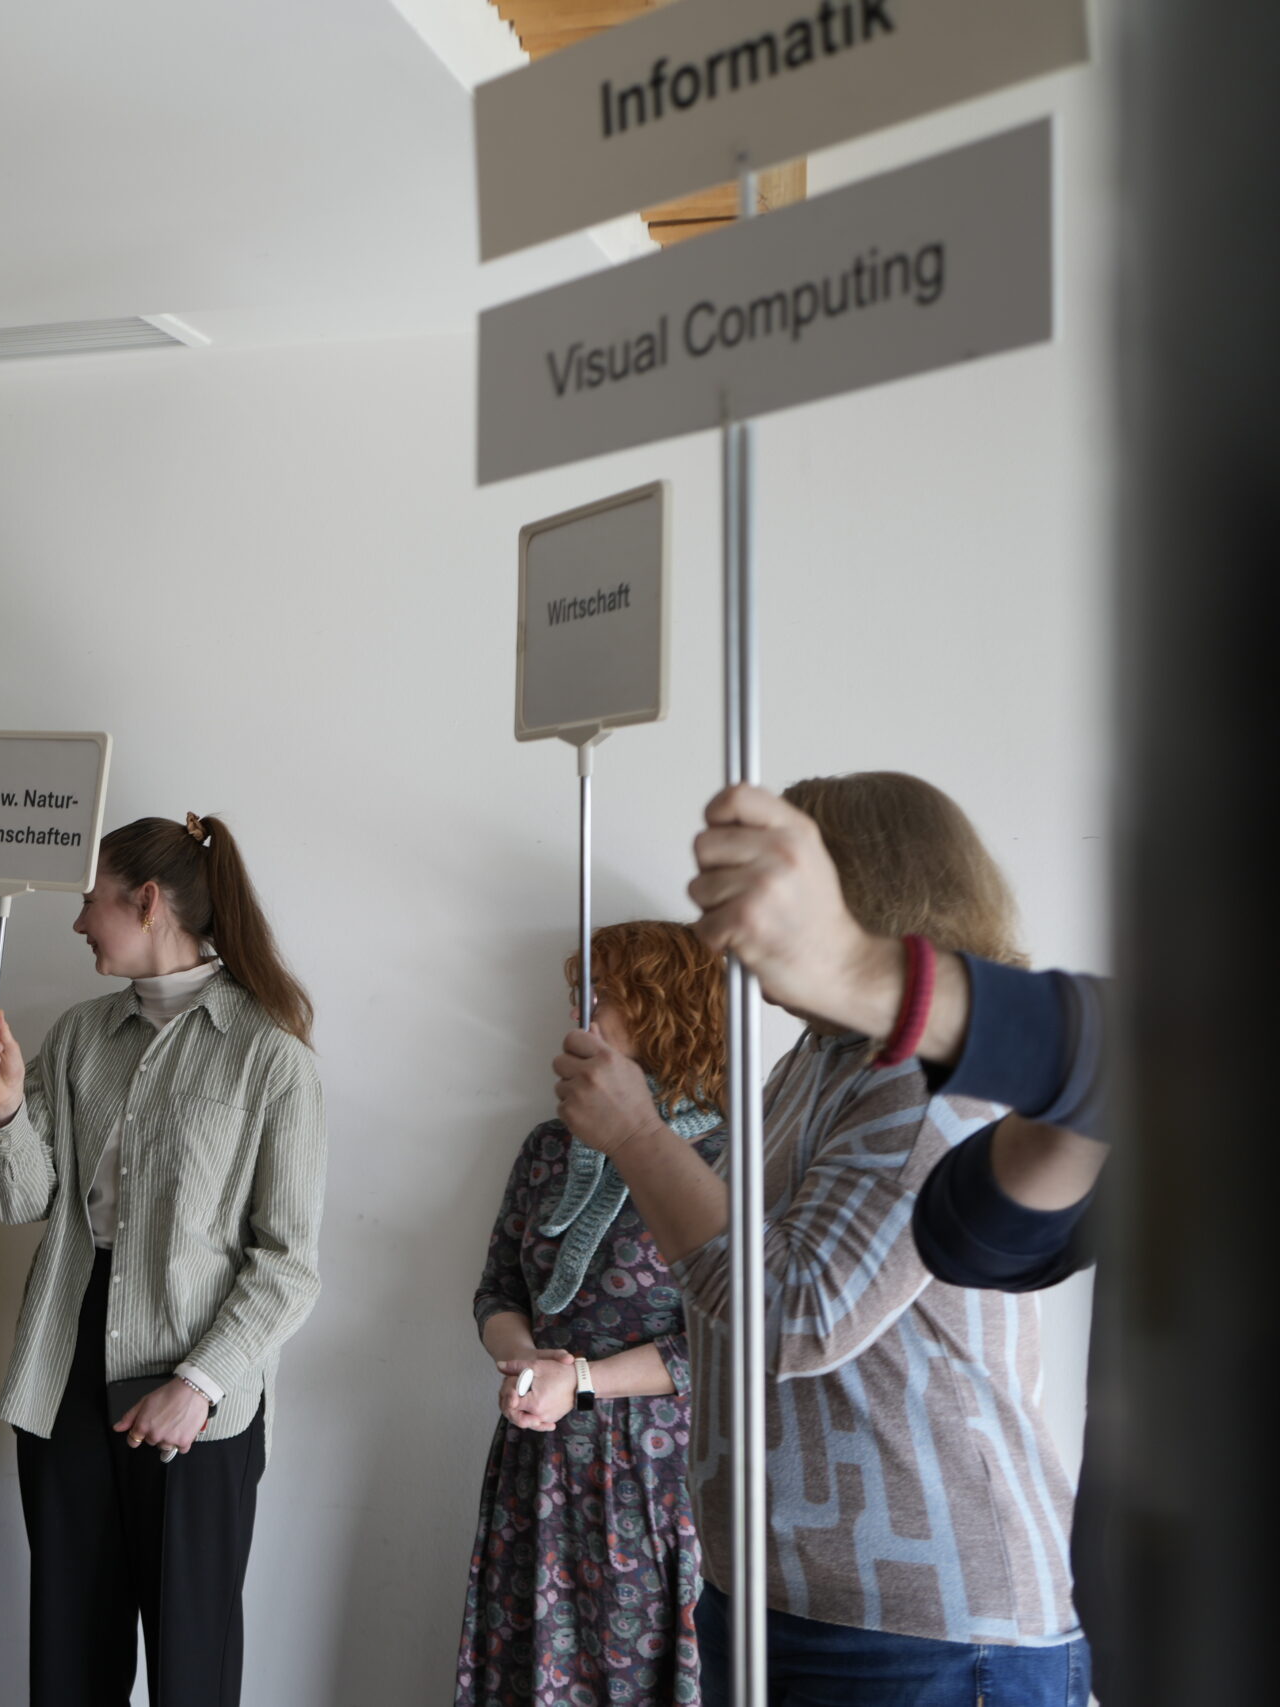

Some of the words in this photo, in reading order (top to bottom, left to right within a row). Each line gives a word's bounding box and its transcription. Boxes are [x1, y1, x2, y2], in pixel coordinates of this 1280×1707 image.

[599, 0, 895, 138] Informatik
[547, 315, 668, 398] Visual
[683, 240, 946, 358] Computing
[547, 582, 631, 627] Wirtschaft
[23, 789, 79, 809] Natur-
